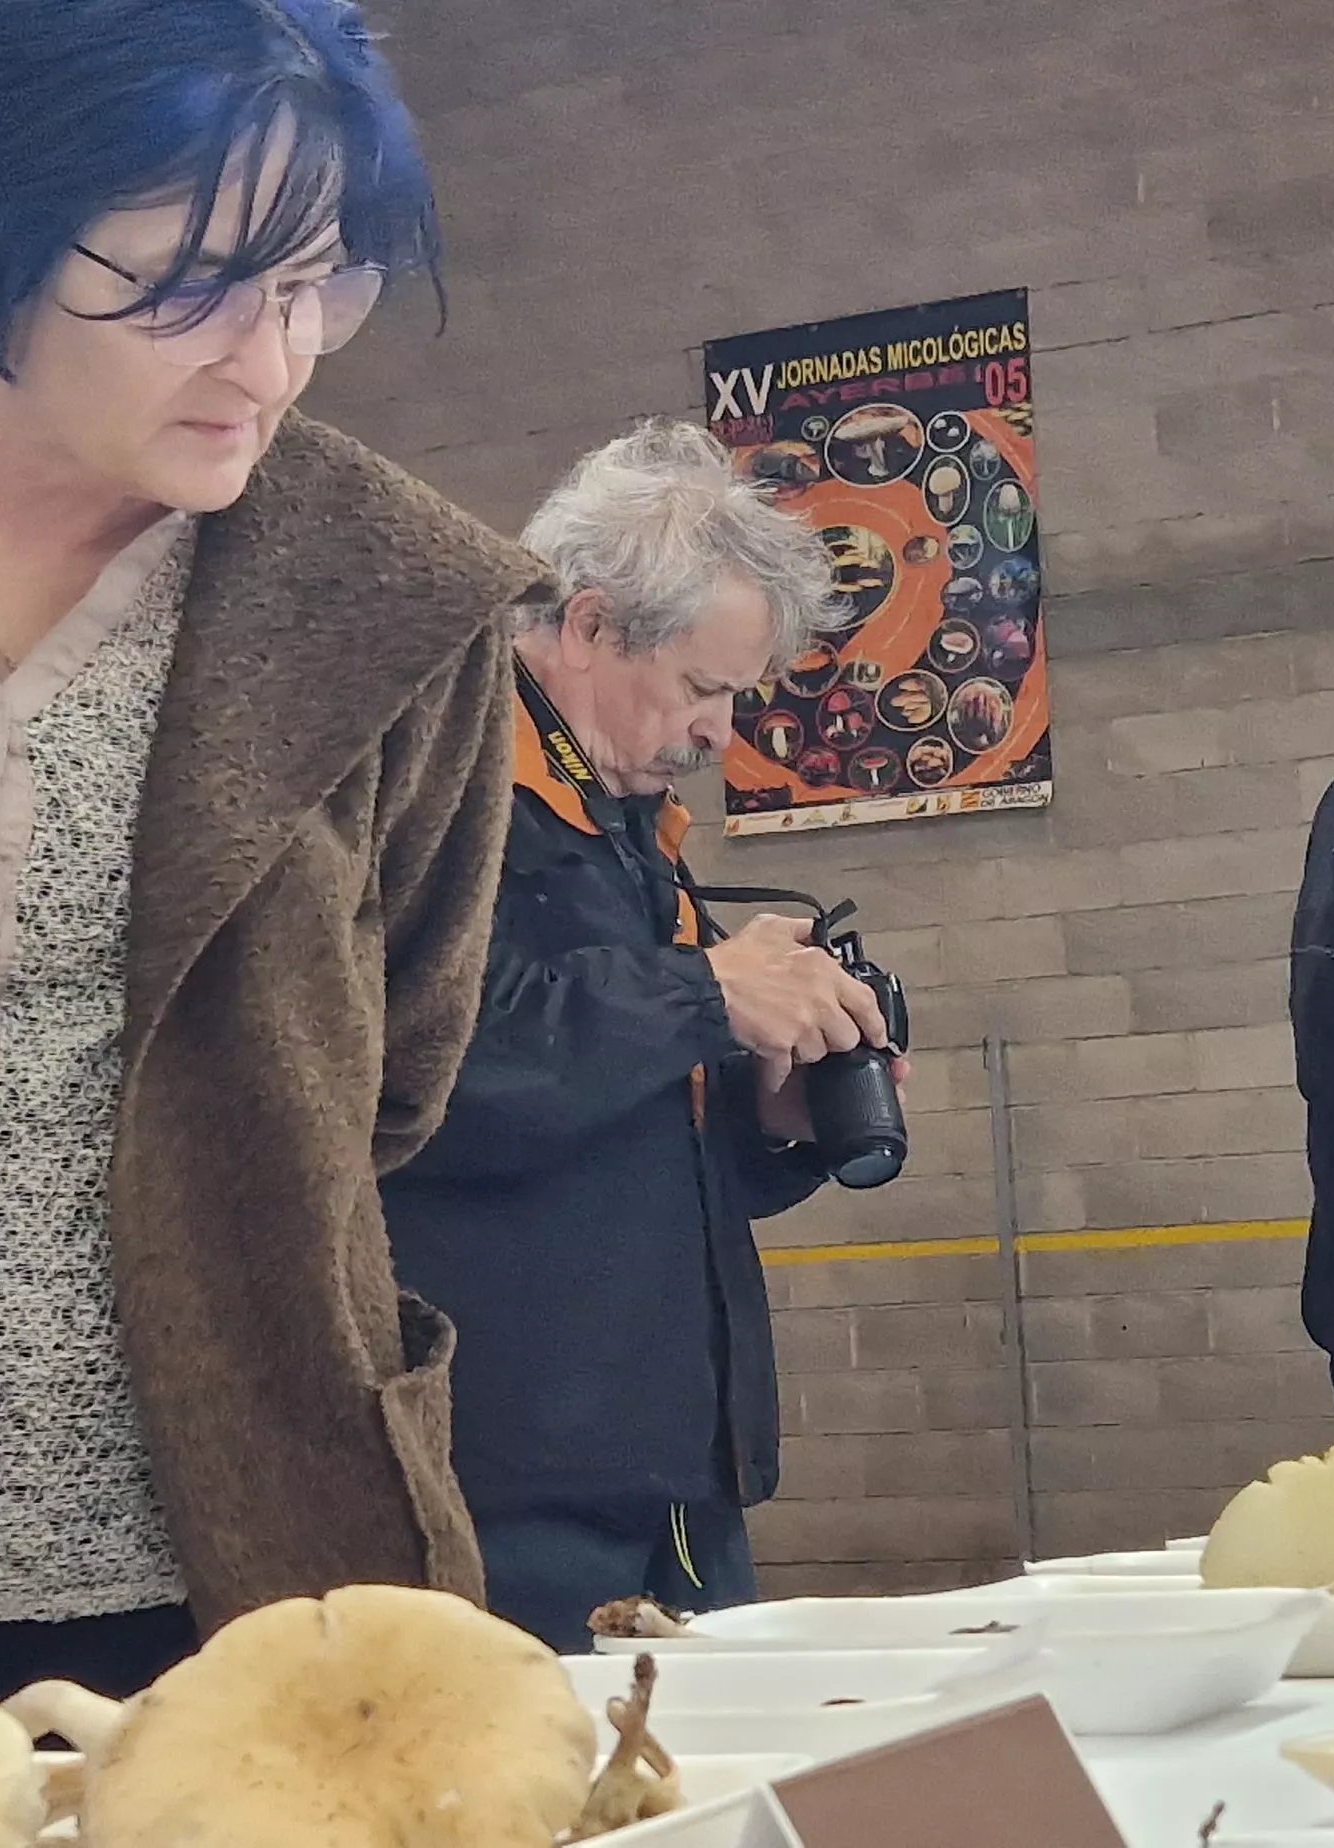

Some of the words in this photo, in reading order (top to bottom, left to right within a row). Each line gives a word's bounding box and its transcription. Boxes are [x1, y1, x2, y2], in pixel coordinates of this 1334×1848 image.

[776, 345, 883, 390] JORNADAS
[887, 320, 1028, 371] MICOLÓGICAS
[709, 362, 775, 422] XV
